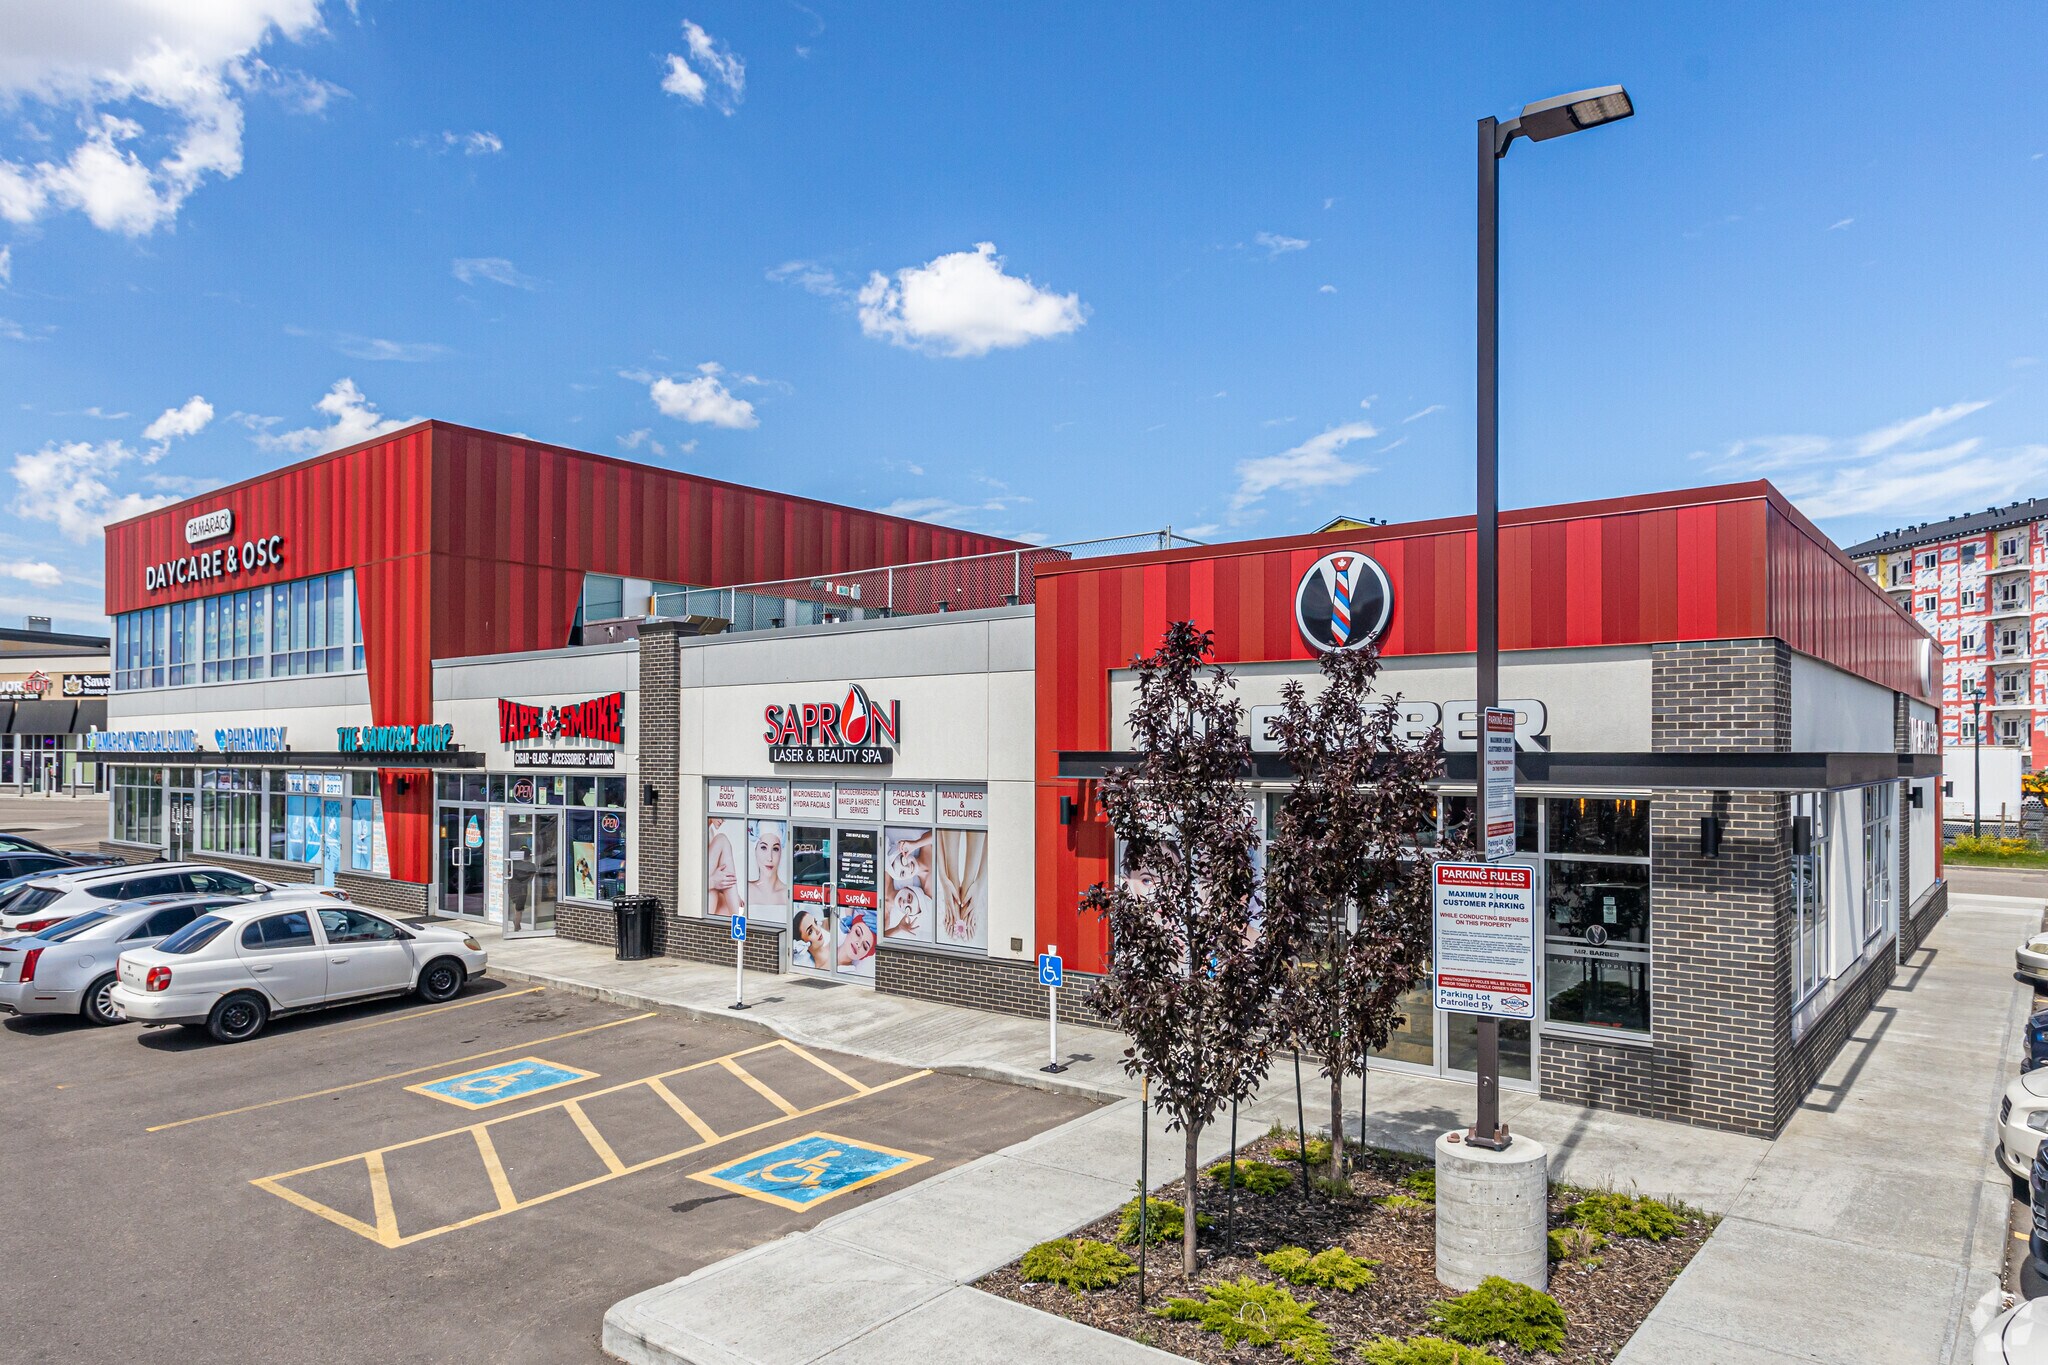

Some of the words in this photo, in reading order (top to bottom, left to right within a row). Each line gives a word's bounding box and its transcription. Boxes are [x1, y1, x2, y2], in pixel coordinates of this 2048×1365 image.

[188, 513, 230, 540] TAMARACK
[146, 549, 223, 591] DAYCARE
[226, 545, 238, 573] &
[242, 535, 282, 570] OSC
[24, 680, 50, 691] HUT
[498, 697, 541, 744] VAPE
[560, 691, 623, 744] SMOKE
[167, 729, 196, 752] CLINIC
[227, 726, 286, 752] PHARMACY
[337, 726, 360, 752] THE
[361, 725, 415, 752] SAMOSA
[416, 723, 454, 752] SHOP
[515, 752, 530, 764] CIGAR
[532, 752, 549, 764] GLASS
[551, 752, 586, 765] ACCESSORIES
[588, 753, 614, 765] CARTONS
[774, 748, 804, 762] LASER
[806, 749, 814, 762] &
[817, 749, 859, 763] BEAUTY
[861, 749, 883, 763] SPA
[516, 785, 533, 798] OPEN
[754, 786, 782, 794] THREADING
[792, 790, 831, 798] MICRONEEDLING
[892, 789, 919, 798] FACIALS
[920, 790, 926, 798] &
[749, 794, 768, 802] BROWS
[941, 791, 984, 800] MANICURES
[716, 800, 738, 808] WAXING
[810, 801, 831, 809] FACIALS
[838, 798, 854, 806] MAKEUP
[858, 798, 880, 806] HAIRSTYLE
[892, 798, 926, 807] CHEMICAL
[849, 806, 869, 814] SERVICES
[898, 807, 920, 816] PEELS
[942, 809, 983, 818] PEDICURES
[603, 818, 618, 828] OPEN
[1442, 869, 1487, 880] PARKING
[1490, 871, 1525, 882] RULES
[1448, 890, 1486, 899] MAXIMUM
[1443, 899, 1486, 907] CUSTOMER
[1488, 902, 1525, 910] PARKING
[1458, 913, 1497, 921] CONDUCTING
[1589, 950, 1620, 958] BARBER
[1554, 958, 1592, 967] BARBER
[1594, 963, 1641, 972] SUPPLIES
[1440, 989, 1474, 1001] Parking
[1476, 993, 1491, 1001] Lot
[1440, 998, 1479, 1008] Patrolled
[1481, 1002, 1493, 1011] By
